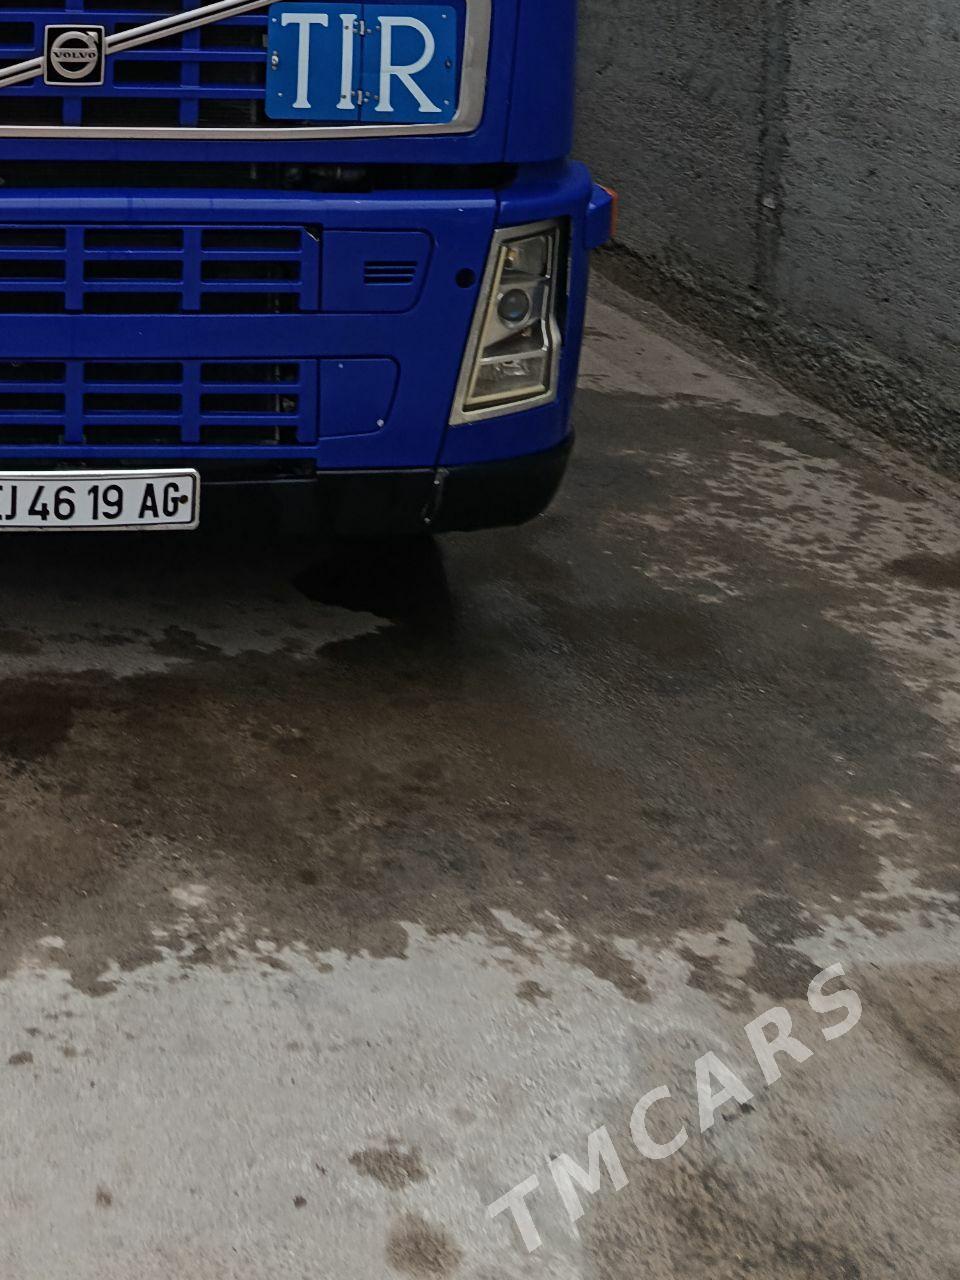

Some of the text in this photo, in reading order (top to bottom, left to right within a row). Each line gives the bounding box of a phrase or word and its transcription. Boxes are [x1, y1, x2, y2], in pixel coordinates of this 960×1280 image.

[52, 51, 97, 59] VOLVO
[280, 12, 442, 113] TIR
[28, 485, 76, 521] 46
[88, 484, 124, 520] 19
[138, 482, 180, 519] AG
